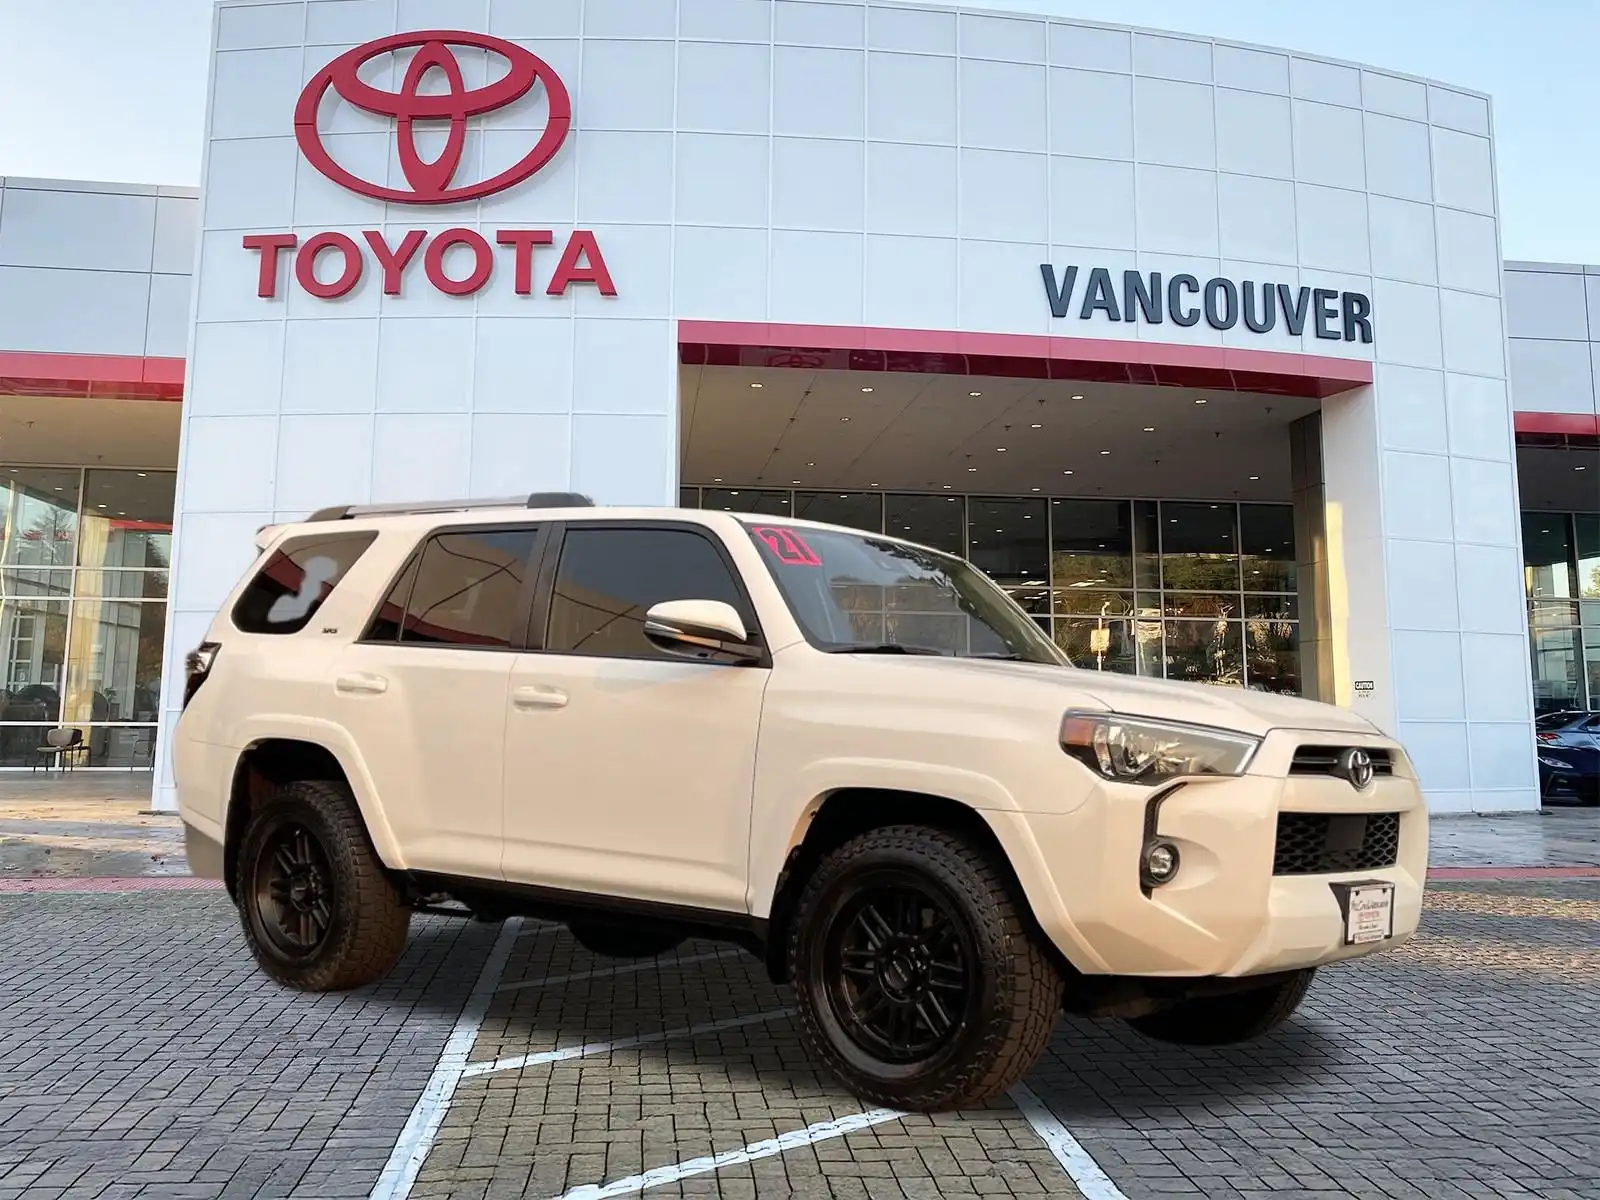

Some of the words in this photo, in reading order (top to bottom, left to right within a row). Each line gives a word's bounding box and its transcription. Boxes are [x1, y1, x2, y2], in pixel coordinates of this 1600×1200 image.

[243, 228, 617, 299] TOYOTA
[1040, 264, 1373, 344] VANCOUVER
[759, 529, 810, 561] 21
